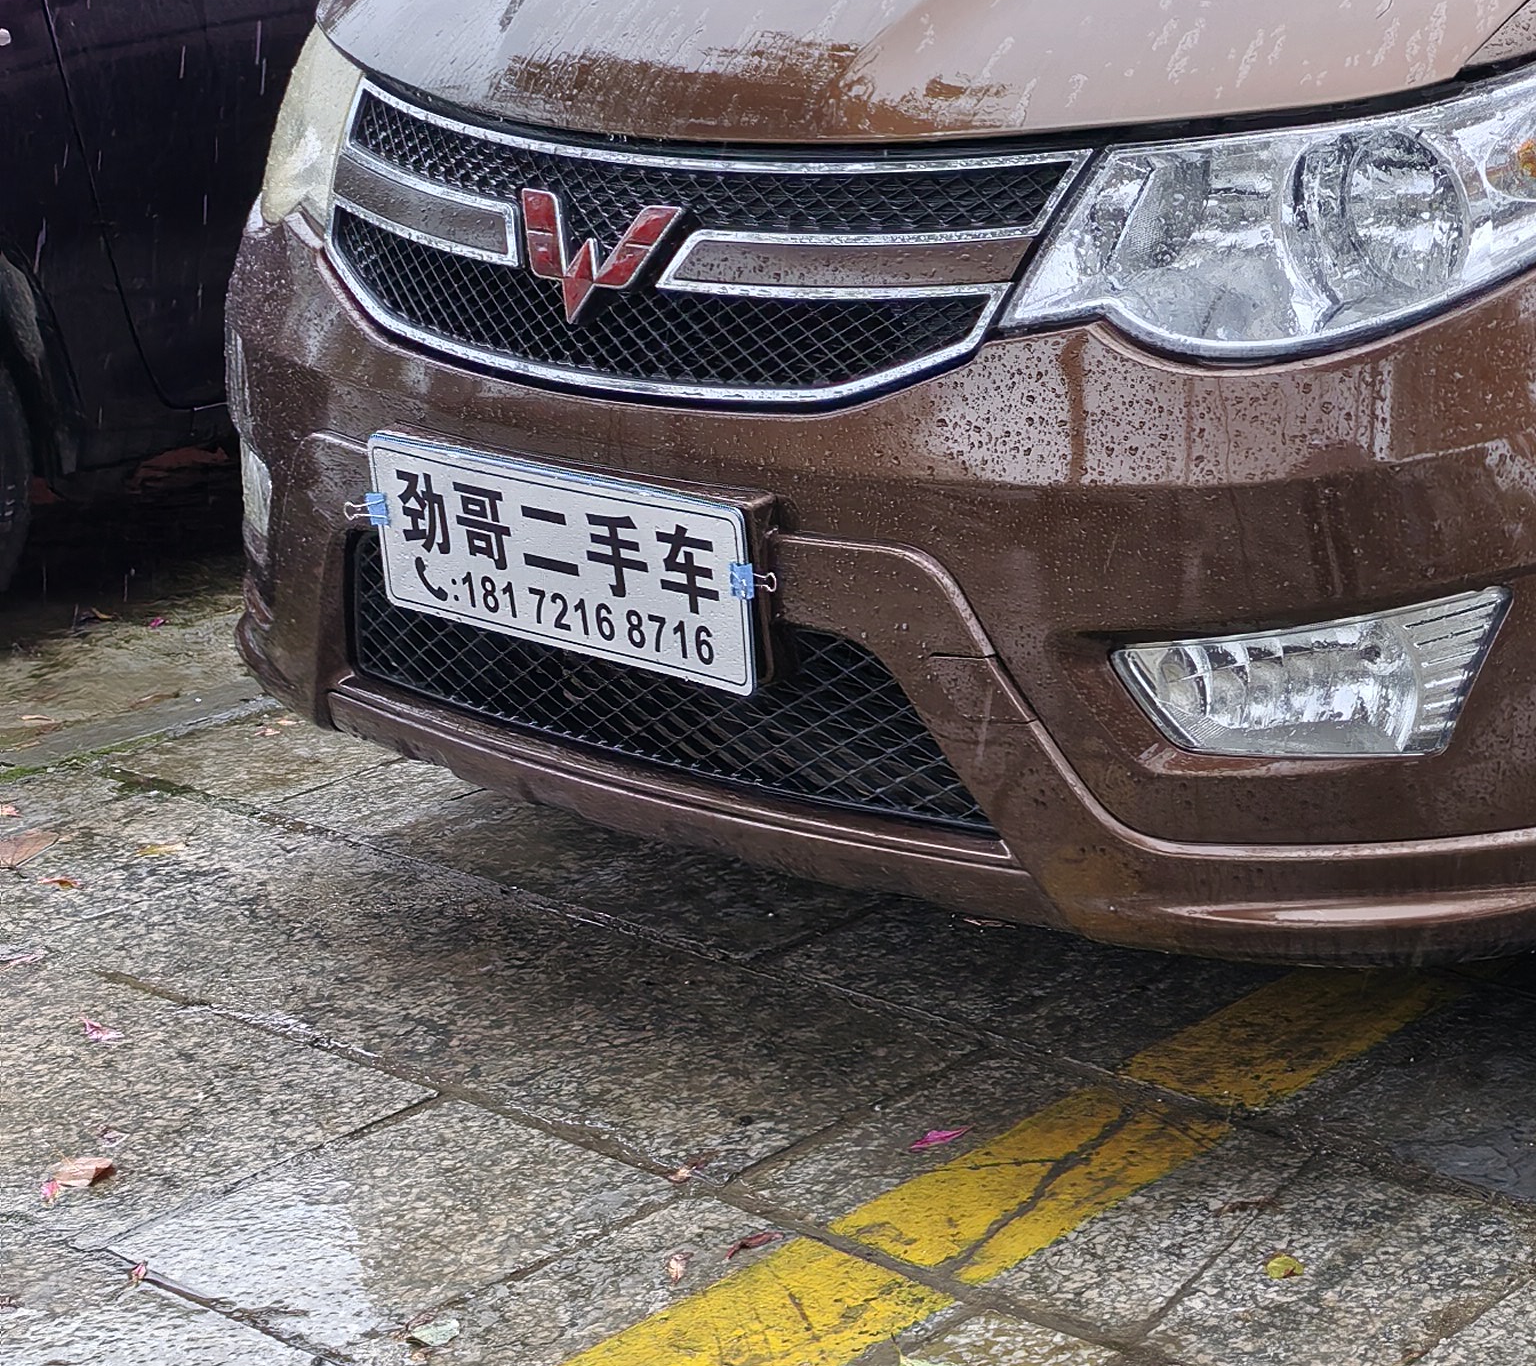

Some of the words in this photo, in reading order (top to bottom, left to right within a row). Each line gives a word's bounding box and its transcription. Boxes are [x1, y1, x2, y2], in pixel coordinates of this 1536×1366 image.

[394, 469, 720, 615] 劲哥二手车
